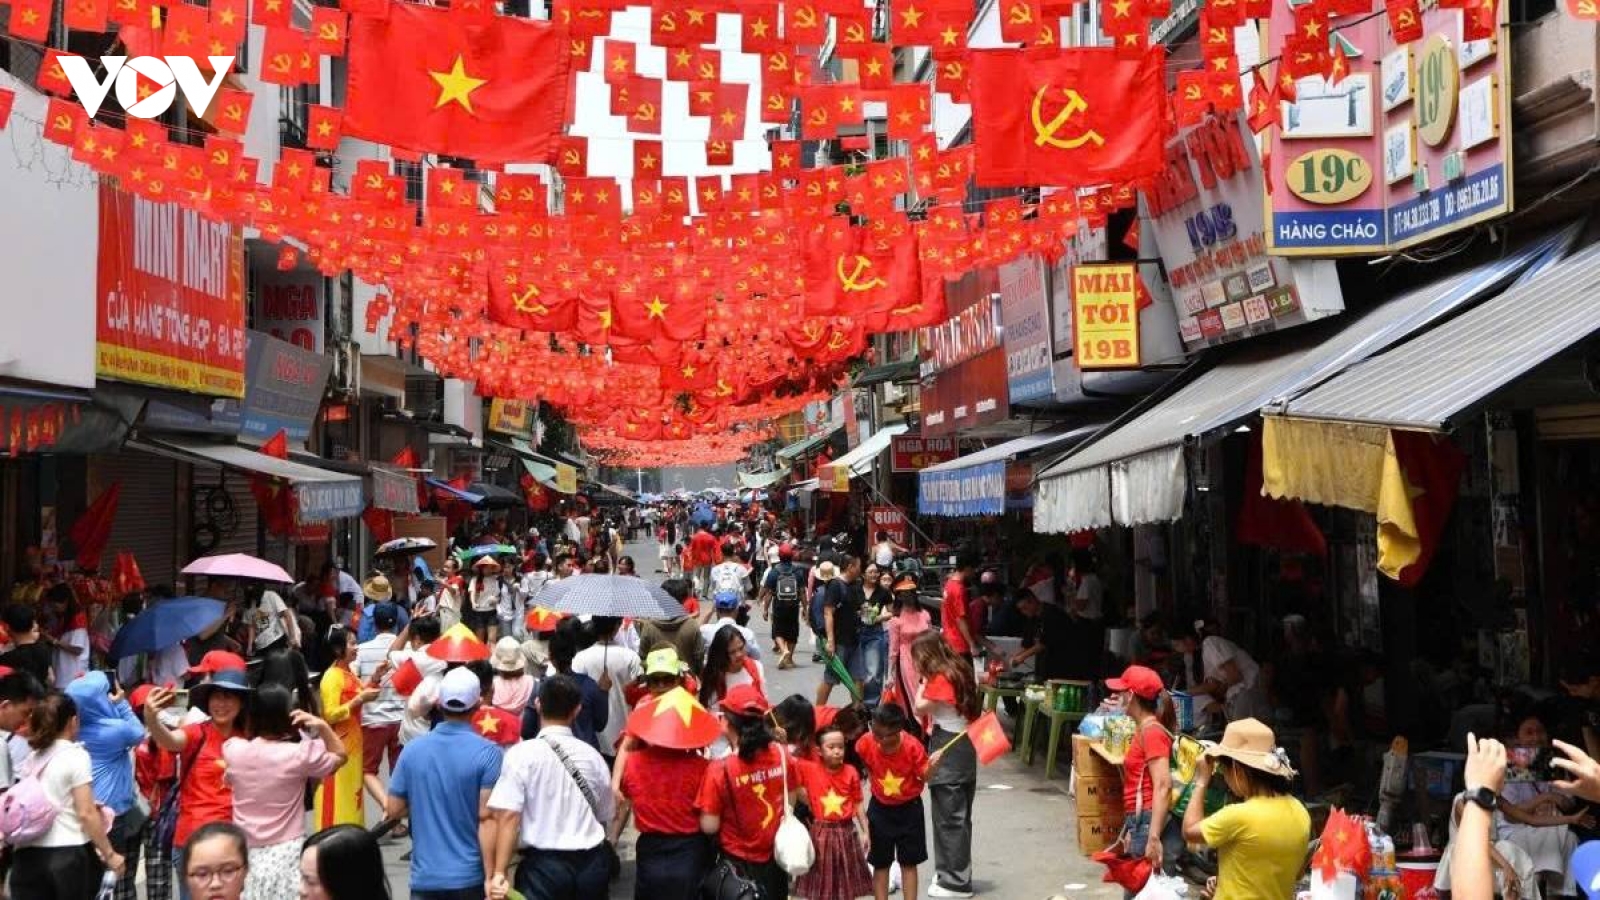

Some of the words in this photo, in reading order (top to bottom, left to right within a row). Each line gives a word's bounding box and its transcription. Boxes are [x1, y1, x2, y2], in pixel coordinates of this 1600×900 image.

[1280, 220, 1326, 240] HÀNG
[1331, 219, 1377, 239] CHÁO
[134, 193, 178, 283] MINI
[183, 207, 231, 300] MART
[1078, 273, 1132, 293] MAI
[1081, 299, 1130, 324] TỚI
[1082, 339, 1132, 361] 19B
